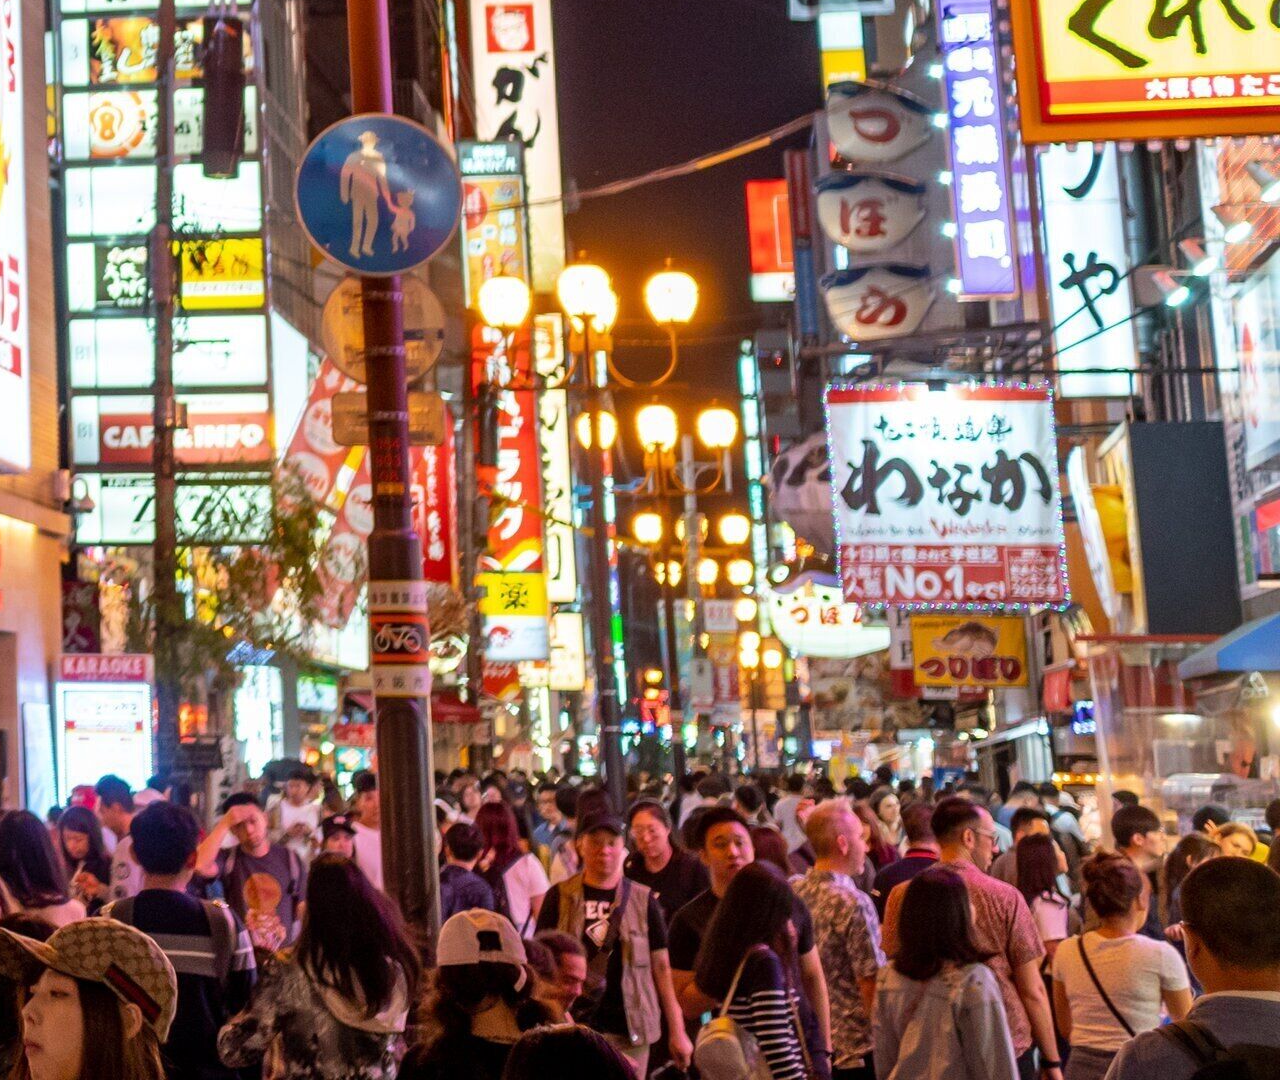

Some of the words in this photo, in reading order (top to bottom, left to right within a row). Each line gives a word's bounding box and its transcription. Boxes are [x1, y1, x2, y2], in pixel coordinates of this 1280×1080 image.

[1146, 76, 1236, 101] 大阪名物
[103, 425, 156, 449] CAF
[841, 439, 1052, 516] わなか
[885, 563, 964, 600] No.1
[63, 656, 145, 673] KARAOKE
